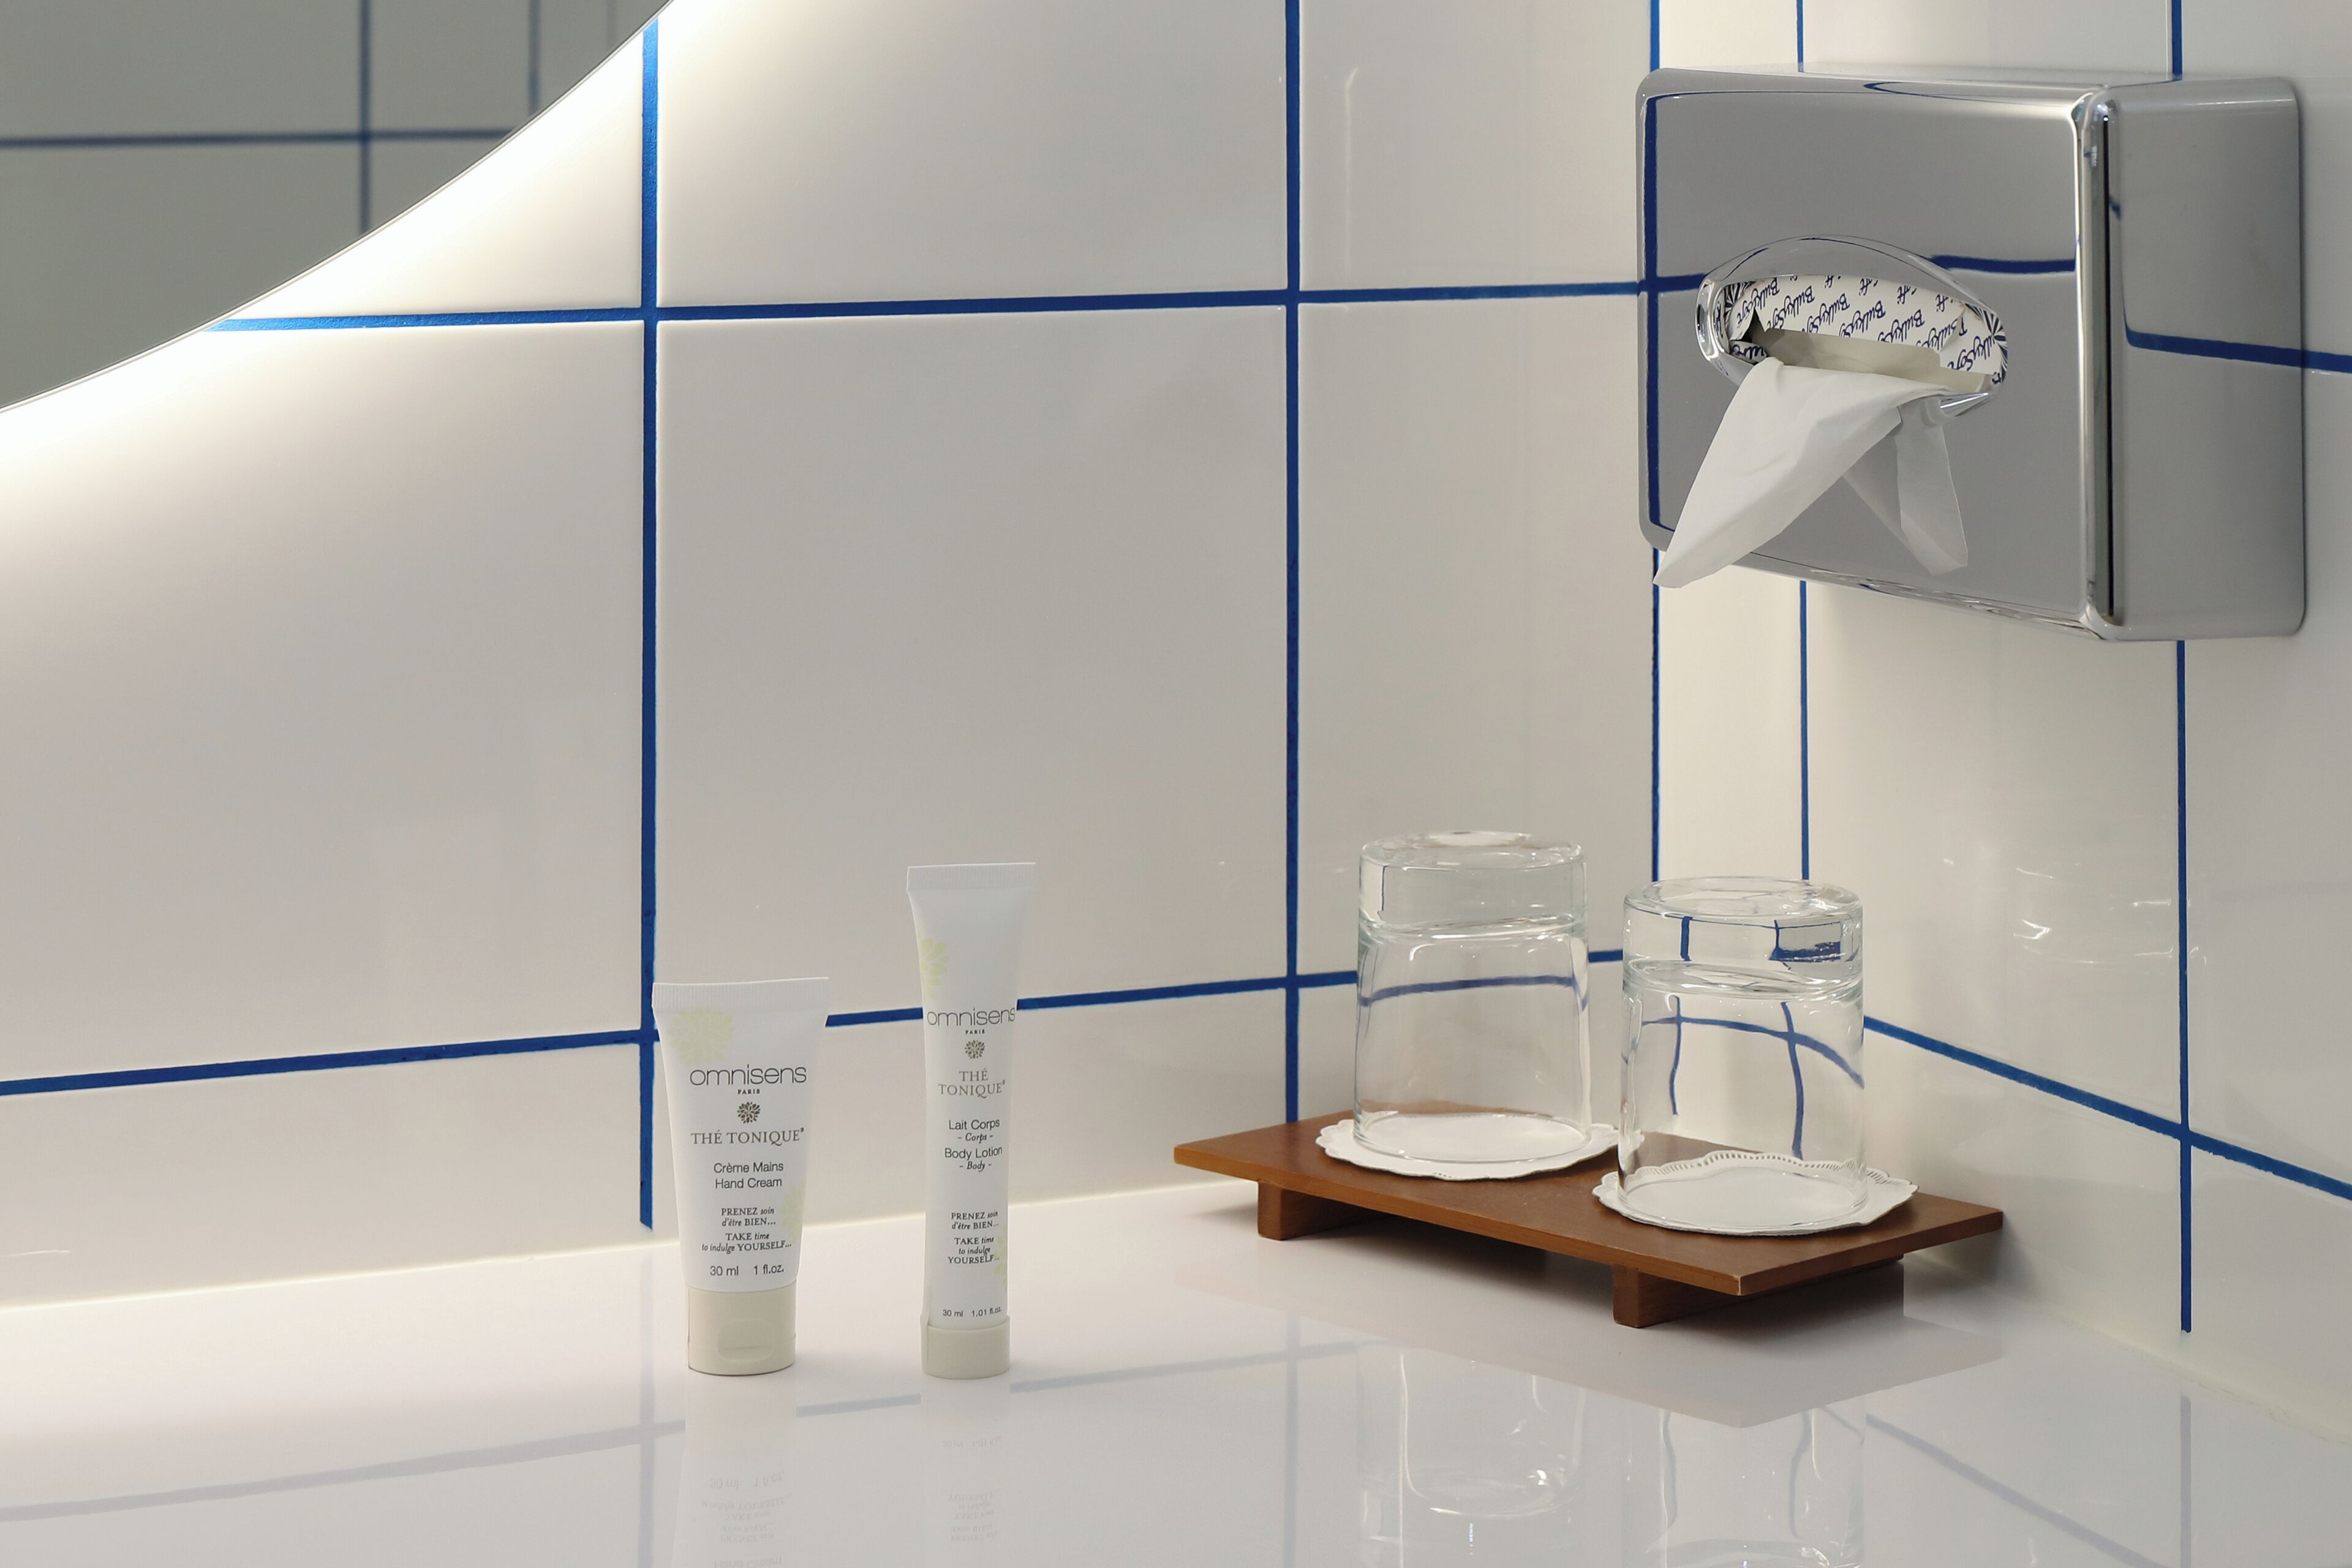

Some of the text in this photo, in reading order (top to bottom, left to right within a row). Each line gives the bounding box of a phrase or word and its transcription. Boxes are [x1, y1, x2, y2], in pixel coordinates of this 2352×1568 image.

[926, 1006, 1016, 1027] omnisens
[690, 1064, 807, 1087] omnisens
[959, 1067, 989, 1082] THÉ
[948, 1118, 1000, 1131] Lait Corps
[690, 1130, 723, 1145] THÉ
[965, 1132, 987, 1144] Corps
[944, 1146, 1003, 1161] Body Lotion
[713, 1161, 784, 1174] Crème Mains
[967, 1160, 986, 1172] Body
[715, 1177, 783, 1189] Hand Cream
[720, 1207, 775, 1216] PRENEZ soin
[951, 1212, 986, 1220] PRENEZ
[722, 1218, 776, 1227] d'être BIEN...
[725, 1232, 770, 1241] TAKE time
[954, 1235, 995, 1245] TAKE time
[701, 1243, 708, 1252] to
[710, 1243, 735, 1254] indulge
[958, 1245, 991, 1257] to indulge
[709, 1263, 785, 1276] 30 ml 1 fl.oz.
[943, 1309, 952, 1317] 30
[971, 1309, 987, 1318] 1.01
